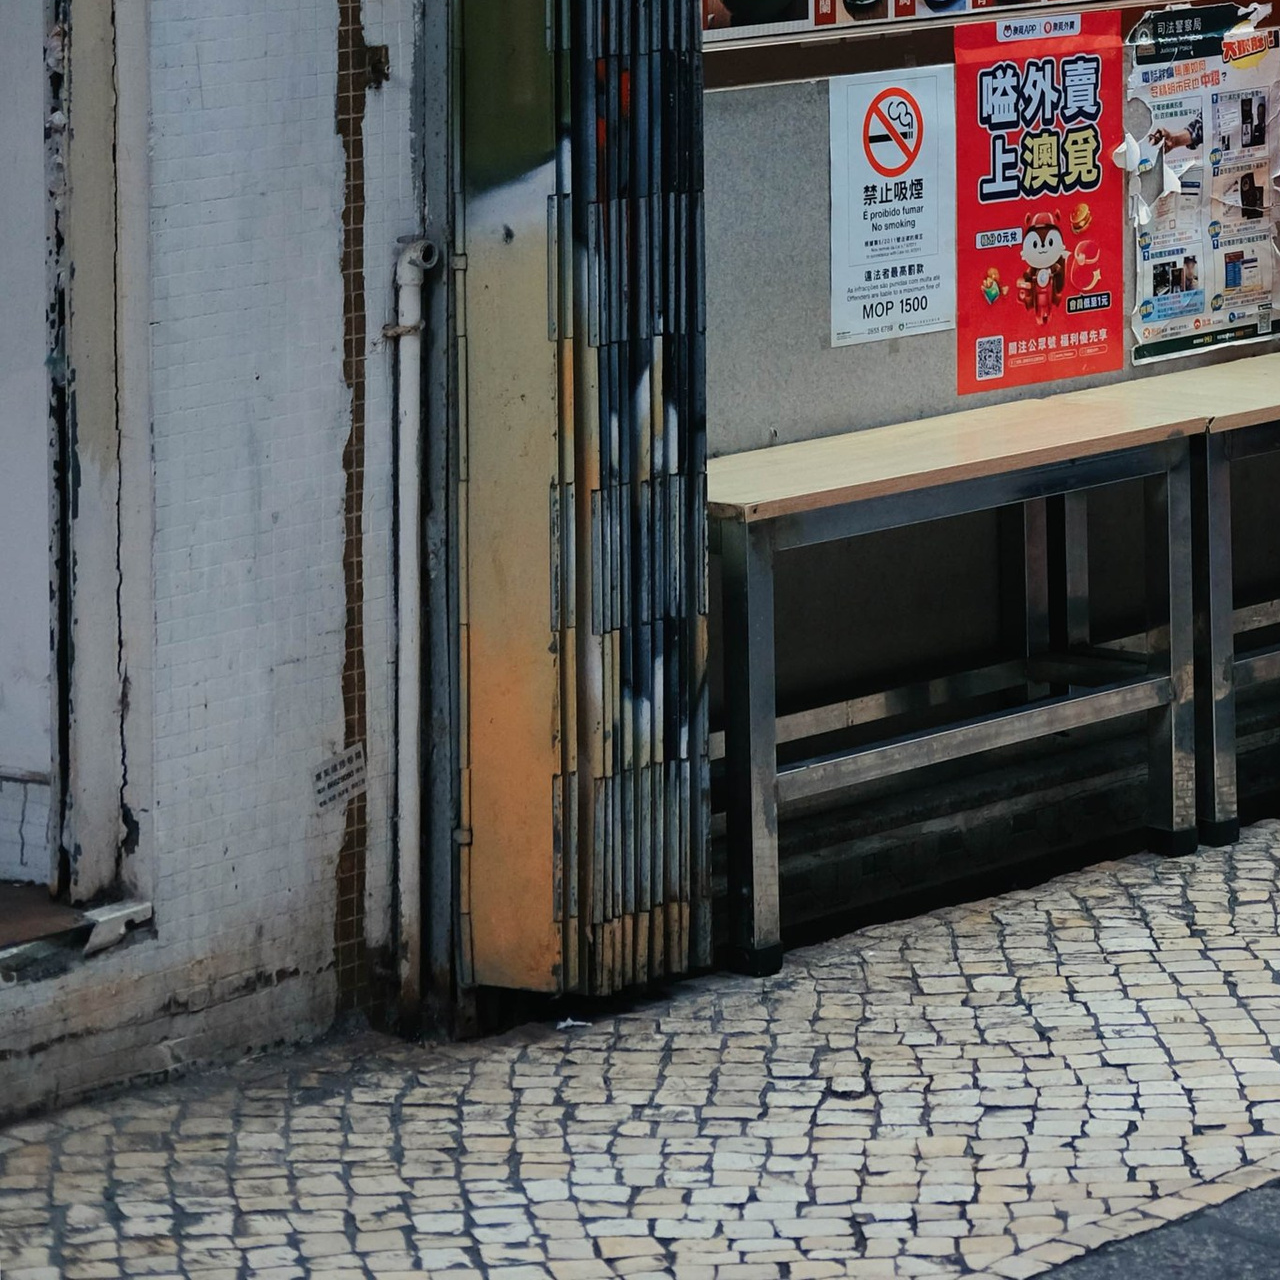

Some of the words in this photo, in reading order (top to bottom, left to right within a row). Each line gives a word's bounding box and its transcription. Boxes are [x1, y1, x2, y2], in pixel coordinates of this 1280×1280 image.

[1157, 18, 1202, 35] 司法警察局
[981, 56, 1099, 126] 嗌外賣
[981, 130, 1098, 197] 上澳覓
[863, 178, 923, 206] 禁止吸煙
[870, 207, 900, 221] proibido
[902, 205, 924, 215] fumar
[872, 223, 882, 232] No
[884, 219, 916, 230] smoking
[863, 301, 894, 319] MOP
[900, 295, 928, 314] 1500
